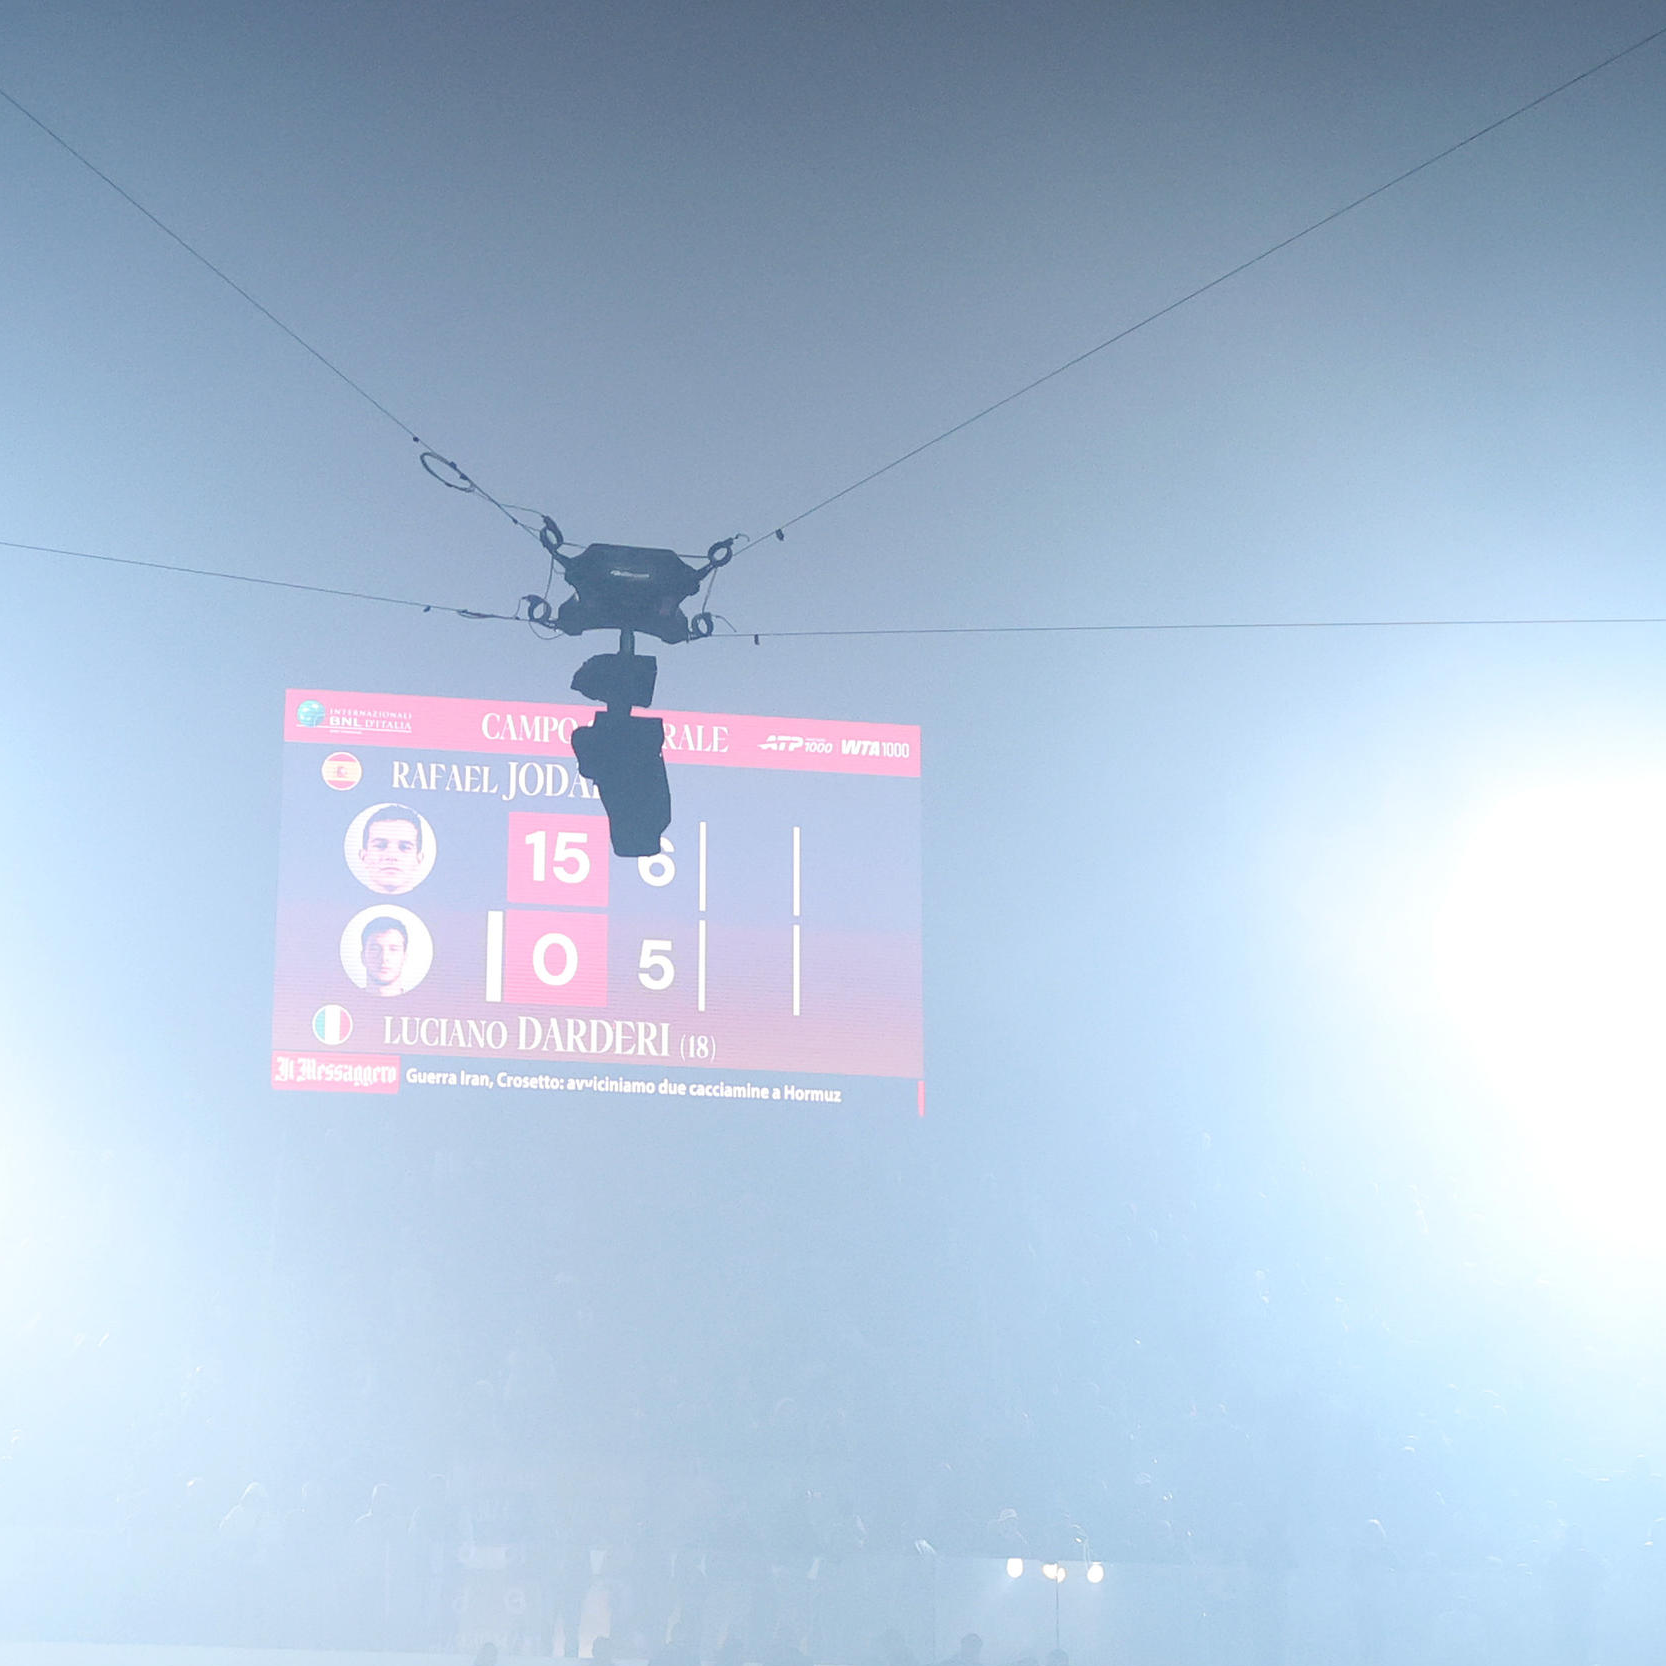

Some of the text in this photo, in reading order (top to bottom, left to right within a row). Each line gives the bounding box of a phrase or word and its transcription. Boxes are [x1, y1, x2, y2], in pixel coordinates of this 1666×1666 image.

[329, 708, 413, 720] INTERNAZIONALI
[329, 716, 413, 731] BNL D'ITALIA
[481, 712, 580, 745] CAMPO
[756, 735, 804, 752] ATP
[391, 760, 499, 794] RAFAEL
[524, 830, 591, 884] 15
[637, 836, 676, 887] 6
[532, 932, 579, 986] 0
[637, 939, 675, 991] 5
[383, 1016, 717, 1062] LUCIANO DARDERI (18)
[296, 1057, 398, 1087] Messaggero
[405, 1067, 842, 1103] Guerra Iran, Crosetto: avviciniamo due cacciamine a Hormuz
